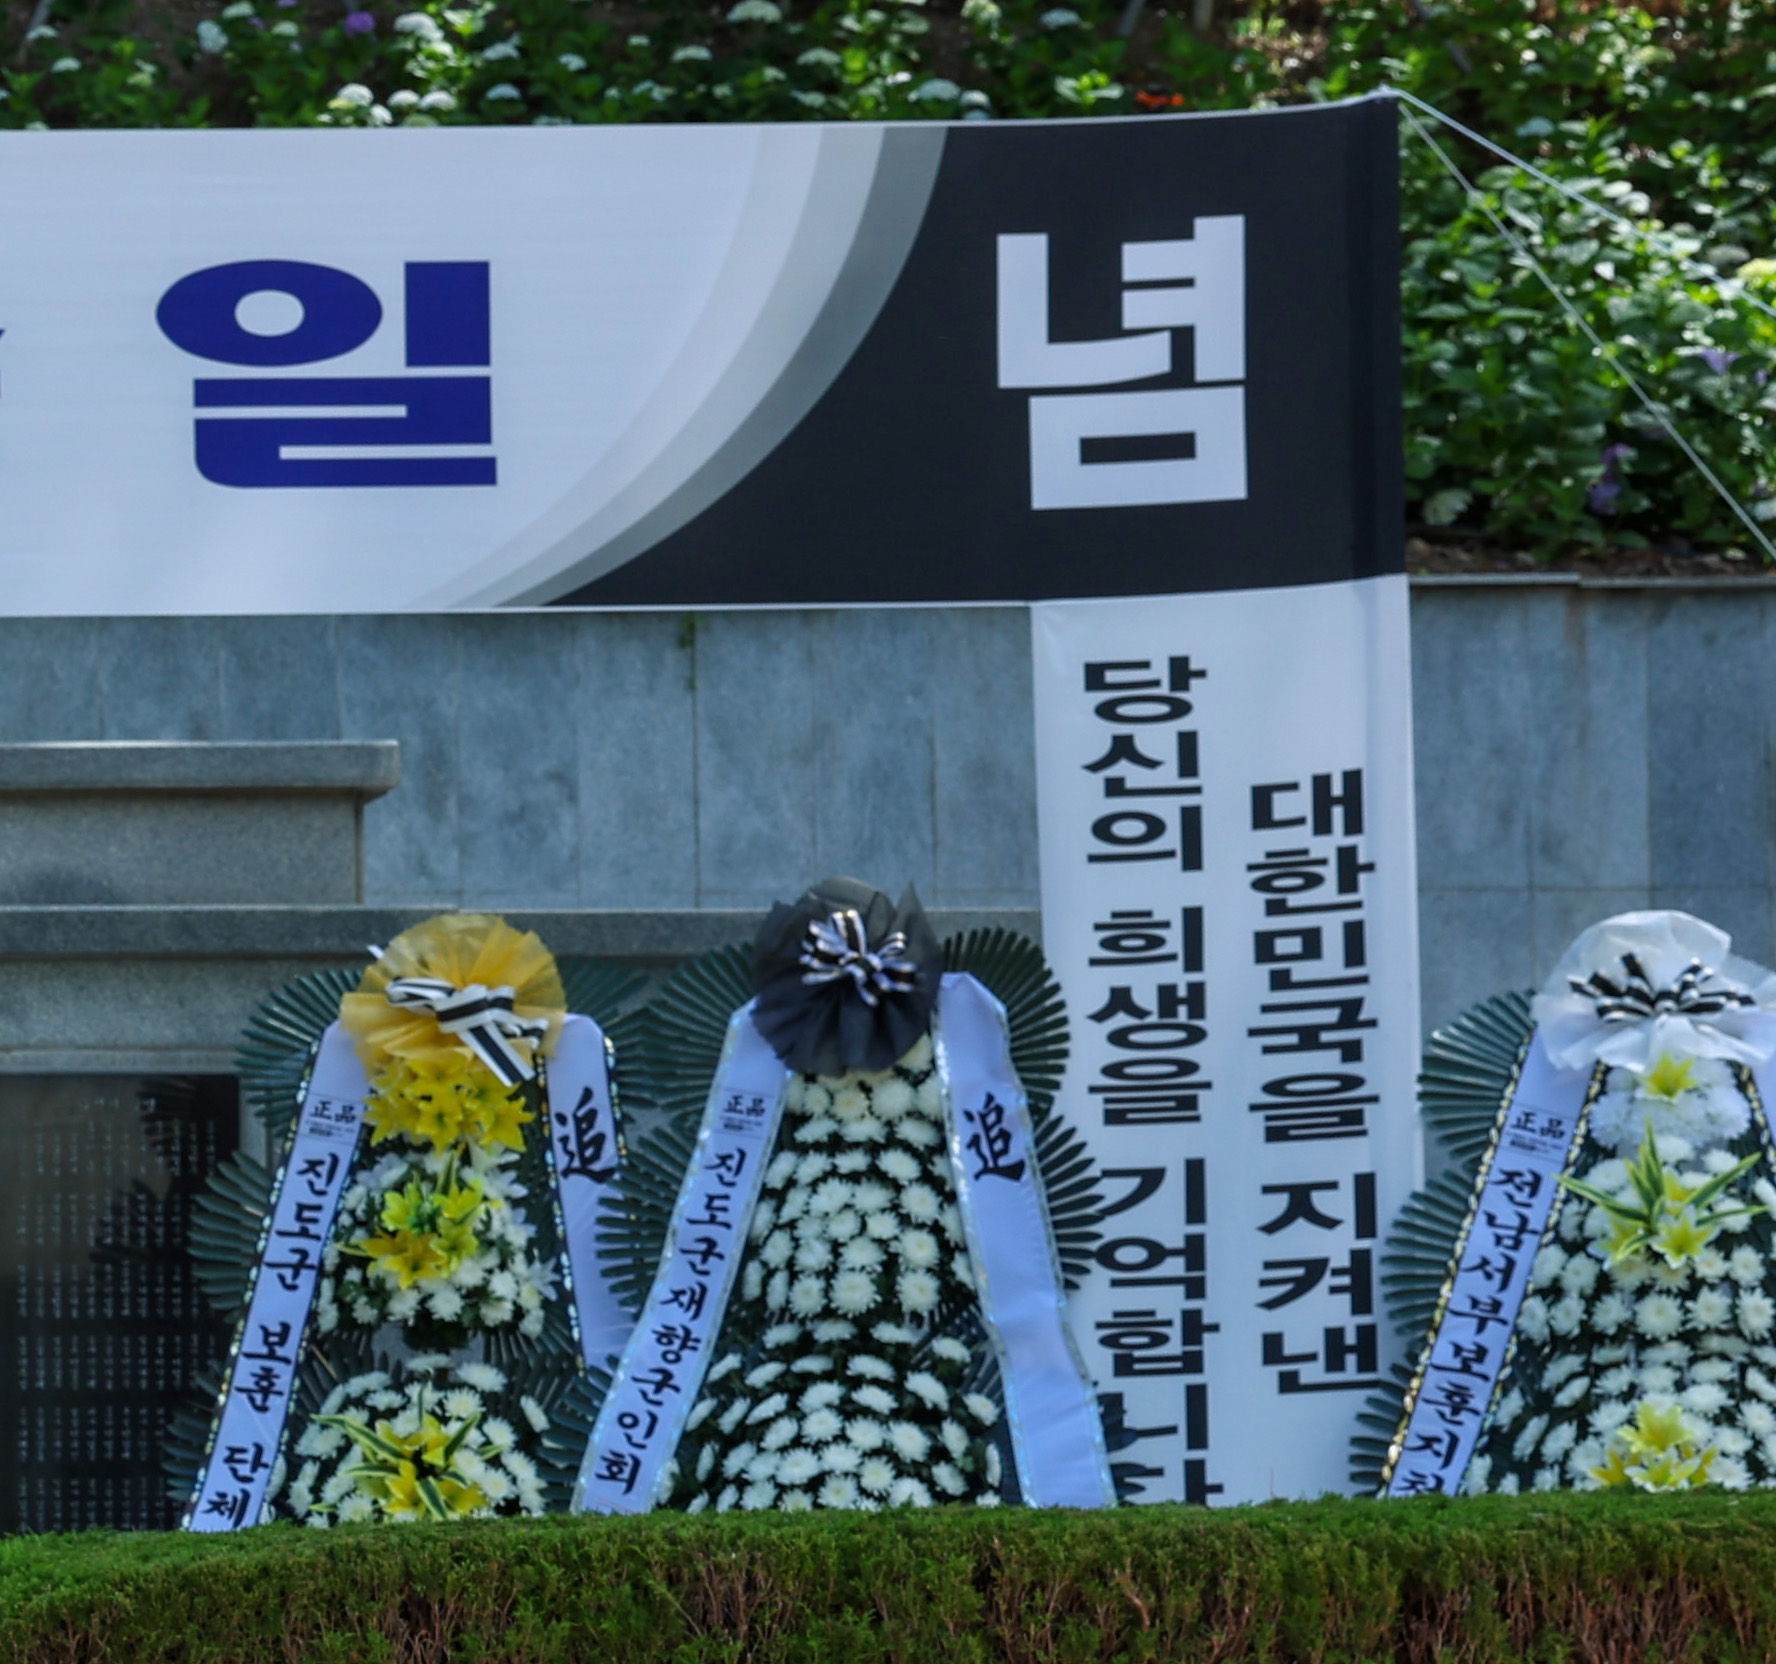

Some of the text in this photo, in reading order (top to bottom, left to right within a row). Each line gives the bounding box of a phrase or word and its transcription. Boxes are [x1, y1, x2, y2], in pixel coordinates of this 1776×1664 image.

[997, 215, 1247, 510] 념
[1083, 655, 1208, 872] 당신의
[1088, 905, 1213, 1127] 희생을
[1247, 768, 1380, 1395] 대한민국을 지켜낸
[263, 1152, 339, 1291] 진도군
[554, 1086, 616, 1185] 追
[963, 1092, 1025, 1183] 追
[235, 1321, 293, 1413] 보훈
[595, 1148, 747, 1495] 진도군재향군인회
[202, 1442, 270, 1528] 단체
